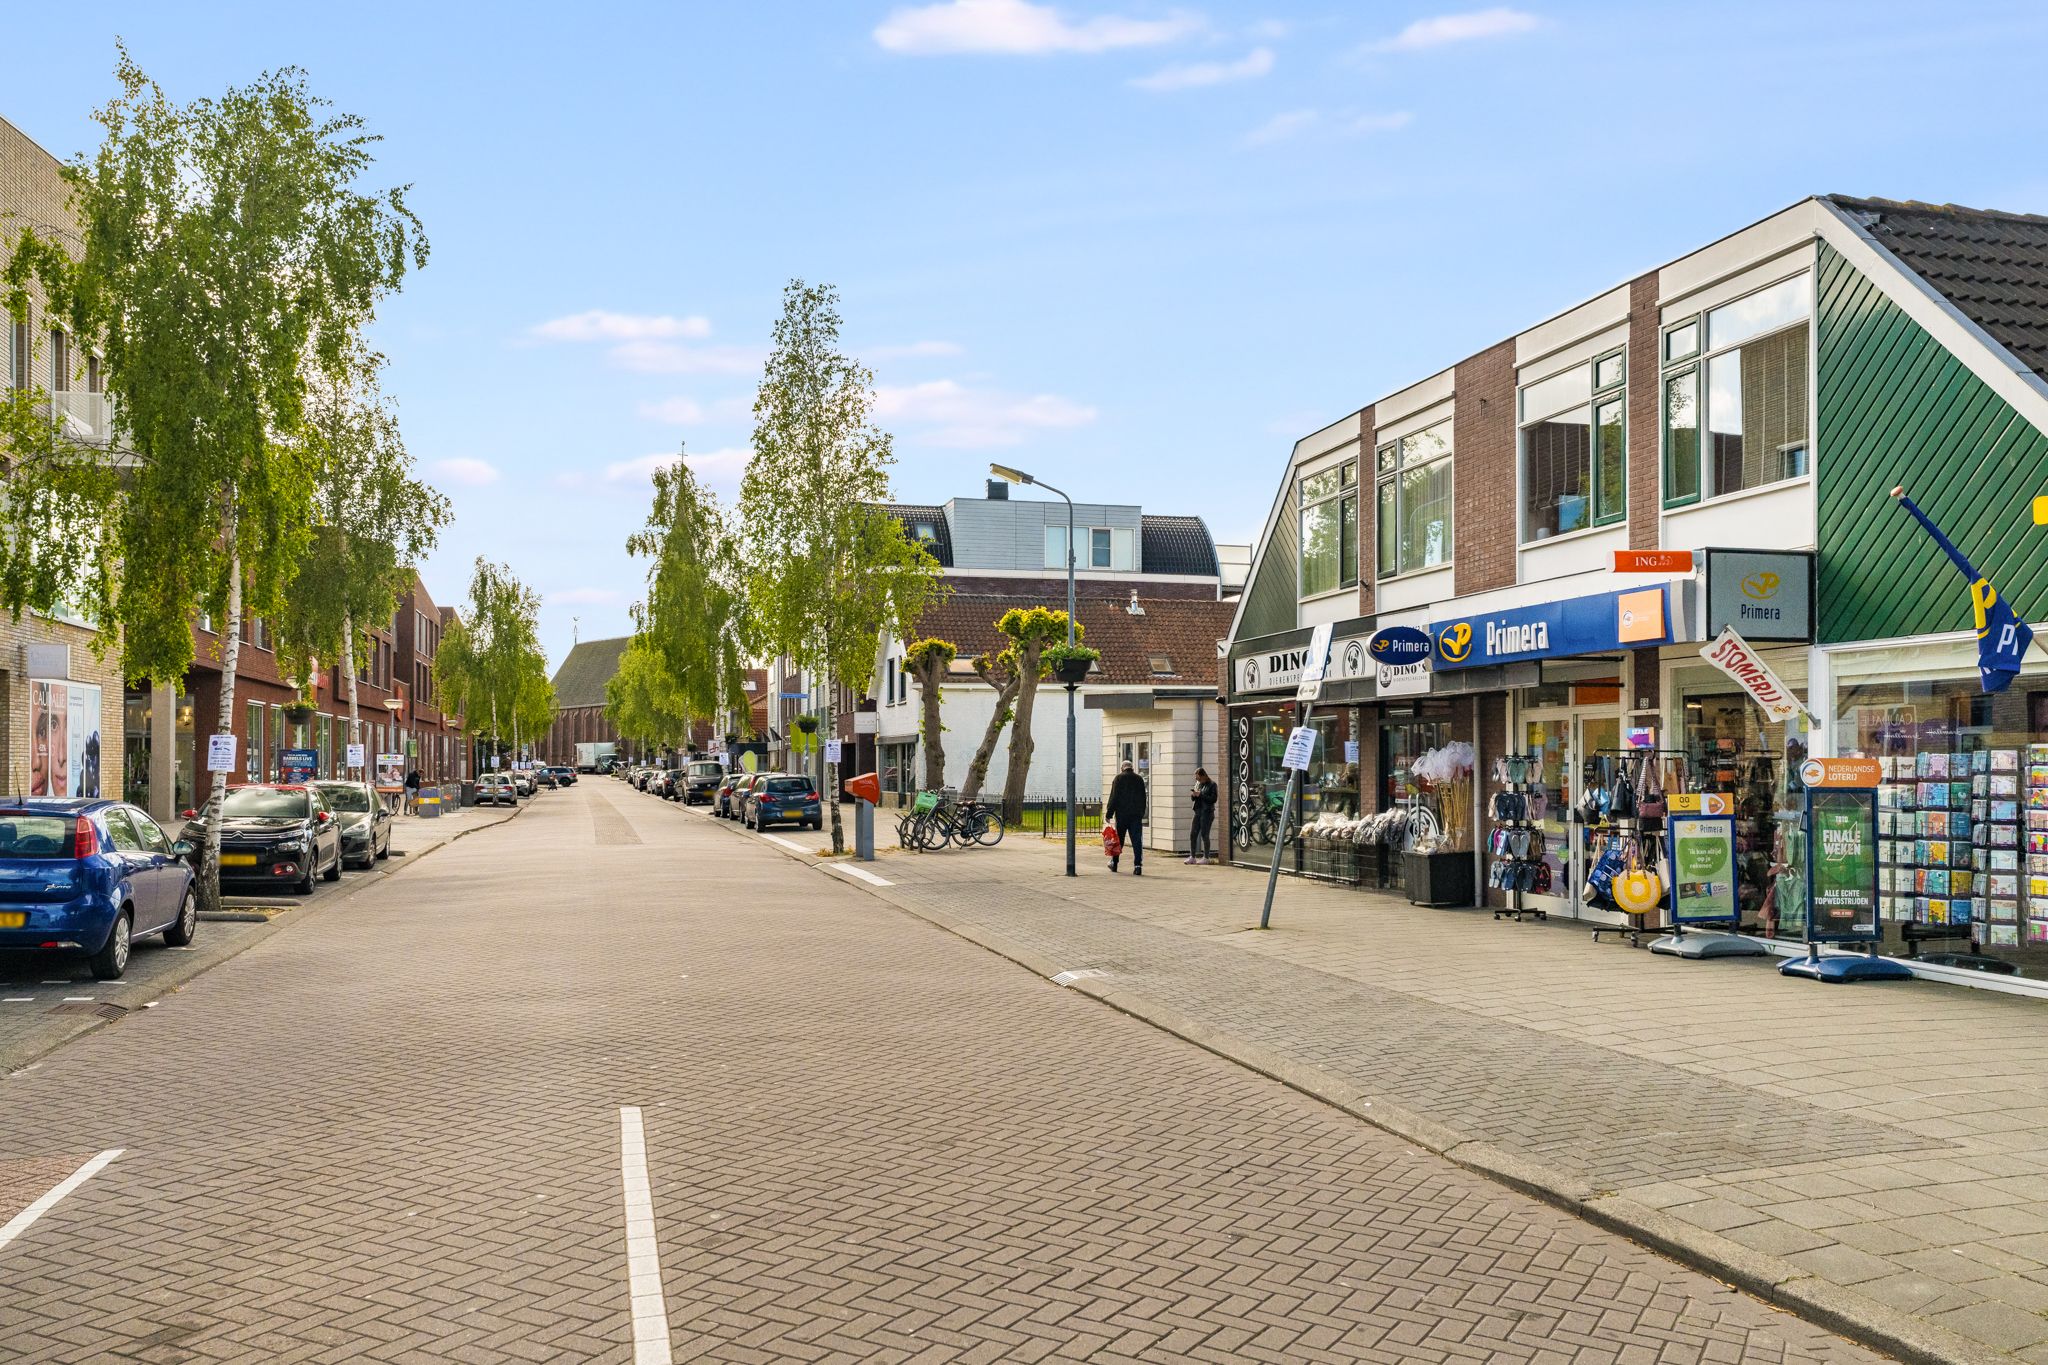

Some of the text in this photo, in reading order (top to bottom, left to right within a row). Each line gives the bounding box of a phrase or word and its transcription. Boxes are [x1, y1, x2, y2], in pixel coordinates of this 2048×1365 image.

[1635, 556, 1657, 567] ING
[1741, 603, 1781, 620] Primera
[1486, 619, 1549, 656] Primera
[1392, 639, 1430, 653] Primera
[1710, 638, 1783, 703] STOMERIJ
[1828, 765, 1876, 773] NEDERLANDSE
[1828, 773, 1858, 781] LOTERIJ
[1699, 824, 1723, 834] Primera
[1823, 829, 1861, 842] FINALE
[1823, 843, 1861, 856] WEKEN
[1824, 889, 1860, 897] ALLE ECHTE
[1814, 897, 1869, 905] TOPWEDSTRIJDEN
